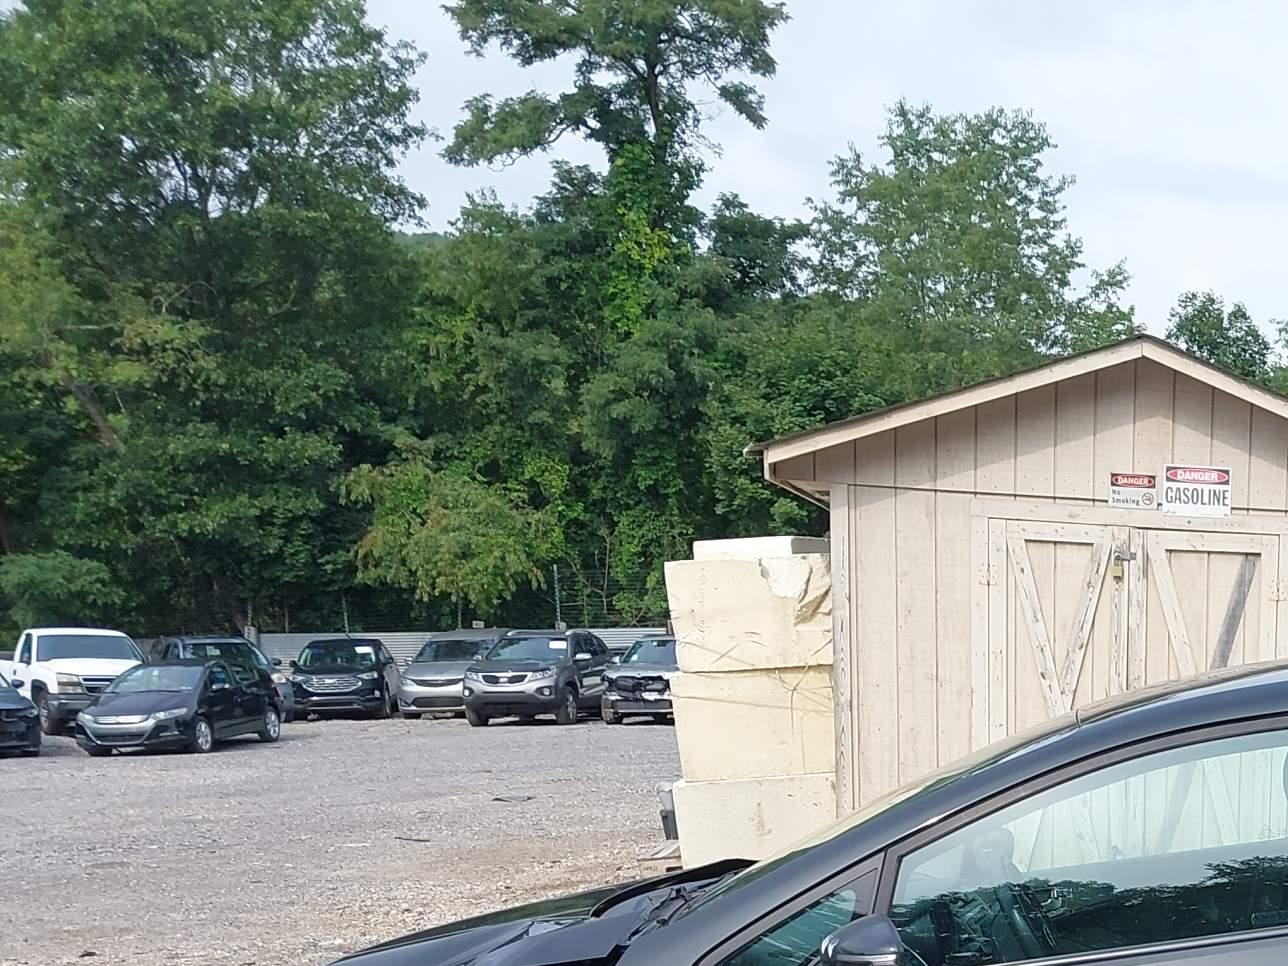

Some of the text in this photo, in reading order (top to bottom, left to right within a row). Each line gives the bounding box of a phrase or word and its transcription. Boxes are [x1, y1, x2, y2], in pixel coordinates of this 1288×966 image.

[1118, 476, 1149, 485] DANGER
[1176, 470, 1218, 481] DANGER
[1111, 488, 1121, 496] No
[1165, 486, 1230, 507] GASOLINE
[1111, 496, 1140, 507] Smoking
